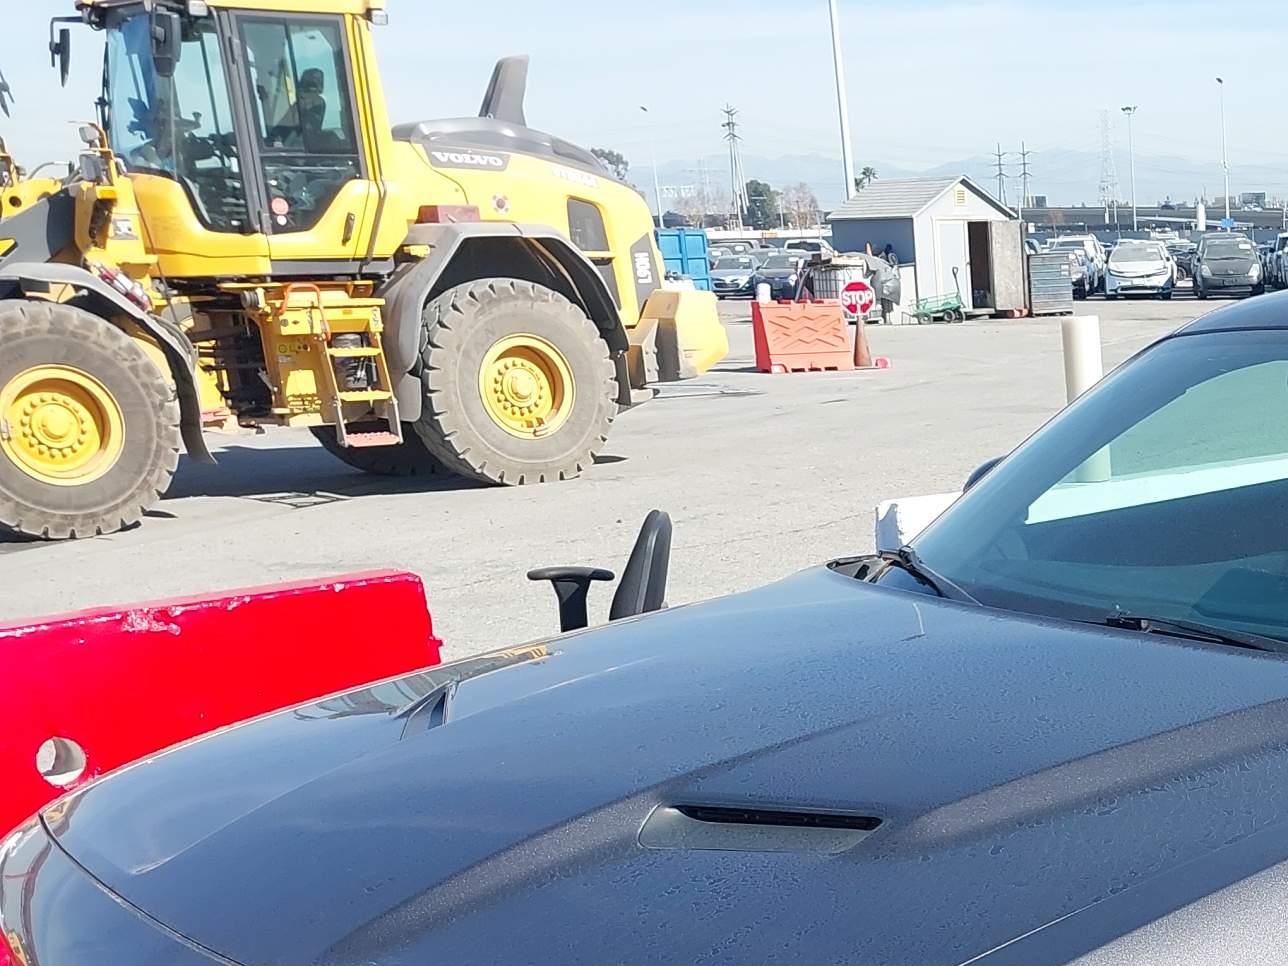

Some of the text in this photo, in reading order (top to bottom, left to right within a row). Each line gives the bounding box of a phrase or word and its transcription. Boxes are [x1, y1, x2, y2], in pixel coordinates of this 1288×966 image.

[432, 151, 504, 167] VOLVO
[634, 252, 653, 284] L90H
[842, 290, 873, 305] STOP
